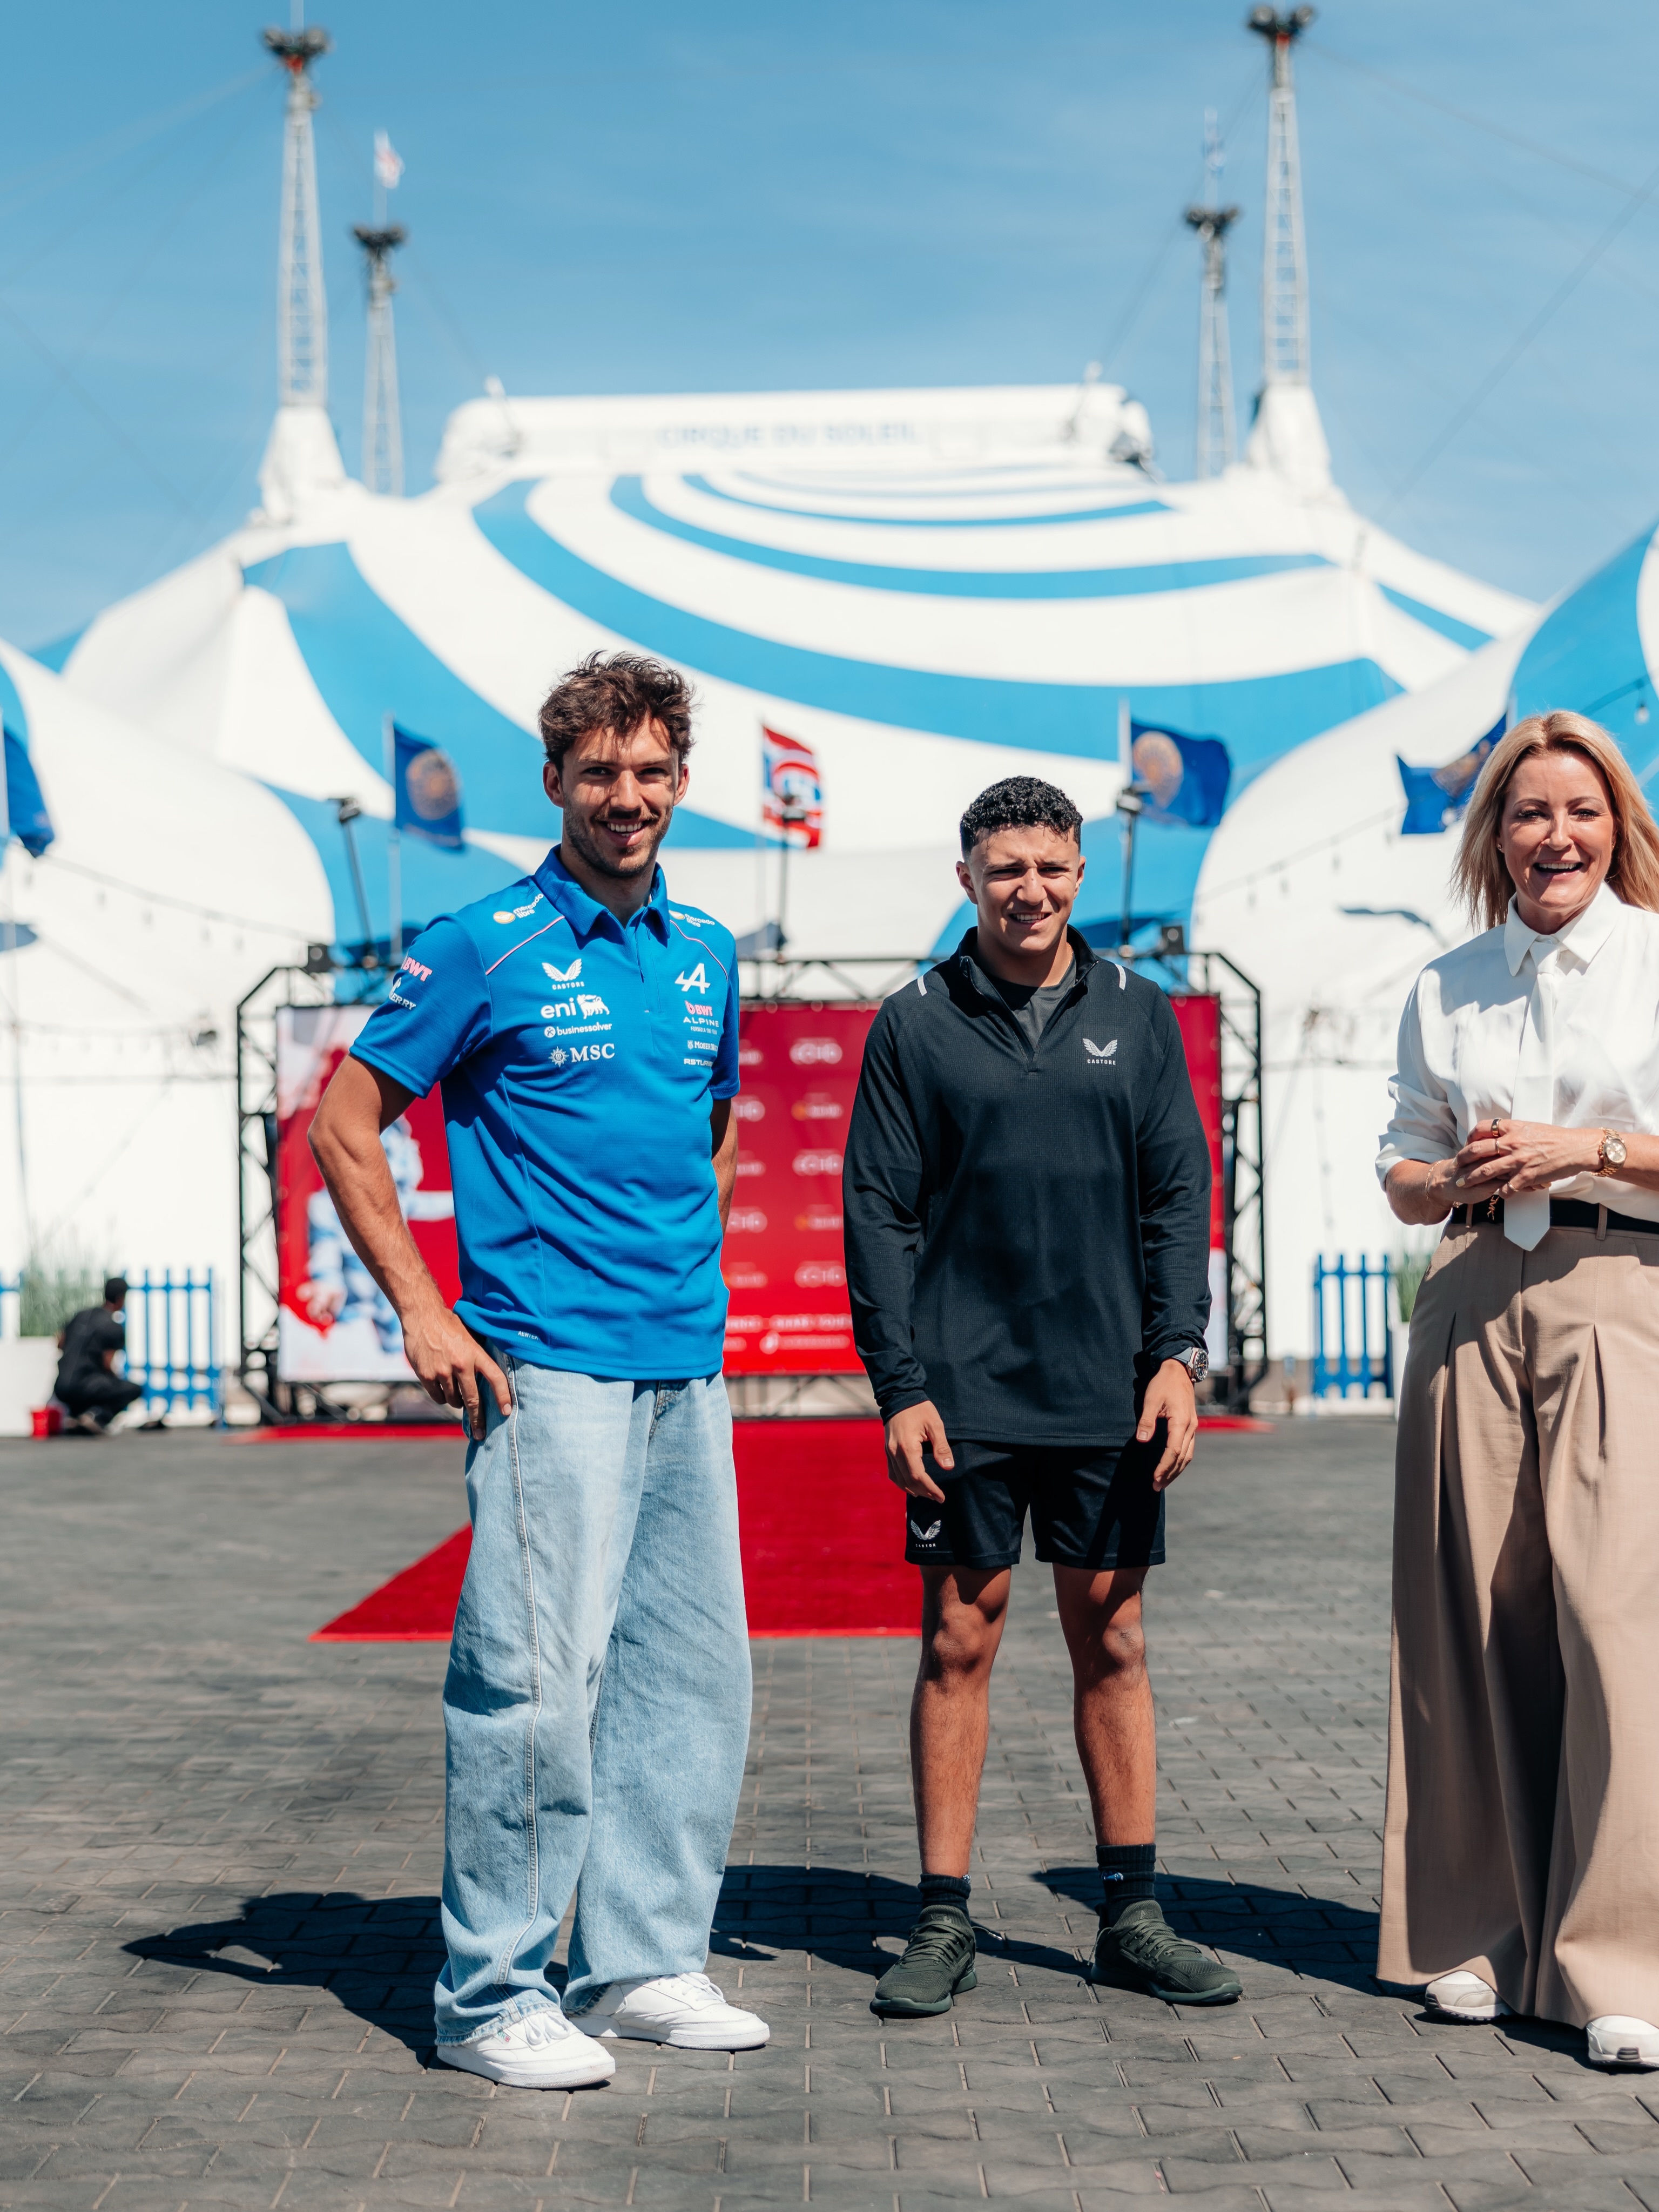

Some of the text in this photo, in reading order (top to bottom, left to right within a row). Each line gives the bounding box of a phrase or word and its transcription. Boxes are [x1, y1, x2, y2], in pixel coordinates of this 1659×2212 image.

[513, 893, 544, 915] mercado
[516, 909, 535, 919] libre
[402, 957, 433, 982] BWT
[552, 982, 585, 990] CASTORE
[541, 997, 577, 1019] eni
[694, 1004, 713, 1017] BWT
[683, 1016, 719, 1027] ALPINE
[557, 1022, 612, 1036] businessolver
[570, 1043, 615, 1063] MSC
